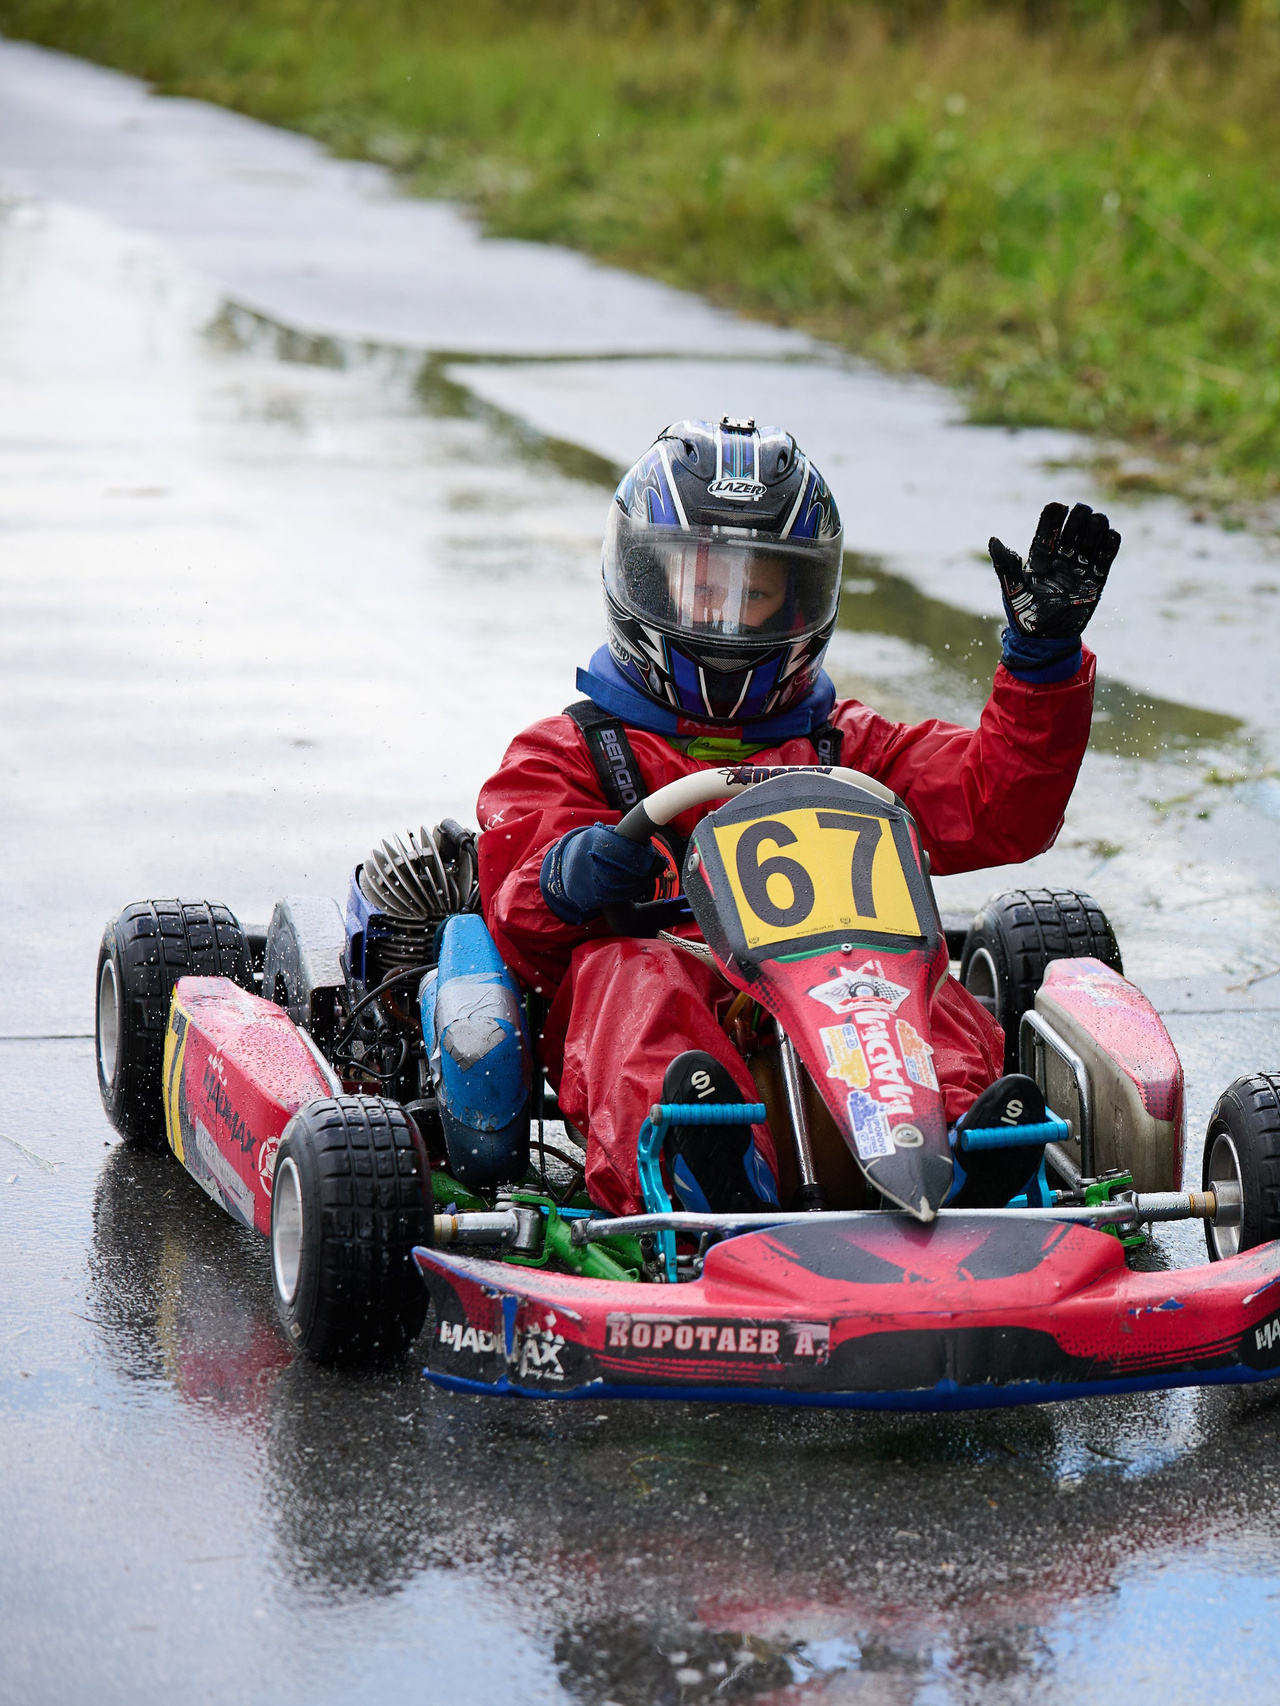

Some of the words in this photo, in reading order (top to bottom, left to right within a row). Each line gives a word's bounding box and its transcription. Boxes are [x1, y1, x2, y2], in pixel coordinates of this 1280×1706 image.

[715, 481, 764, 496] LAZER
[600, 729, 637, 805] BENGIO
[736, 811, 883, 928] 67
[839, 959, 914, 1116] MADMX
[870, 1115, 887, 1154] UPOROVO
[608, 1320, 780, 1354] КОРОТАЕВ
